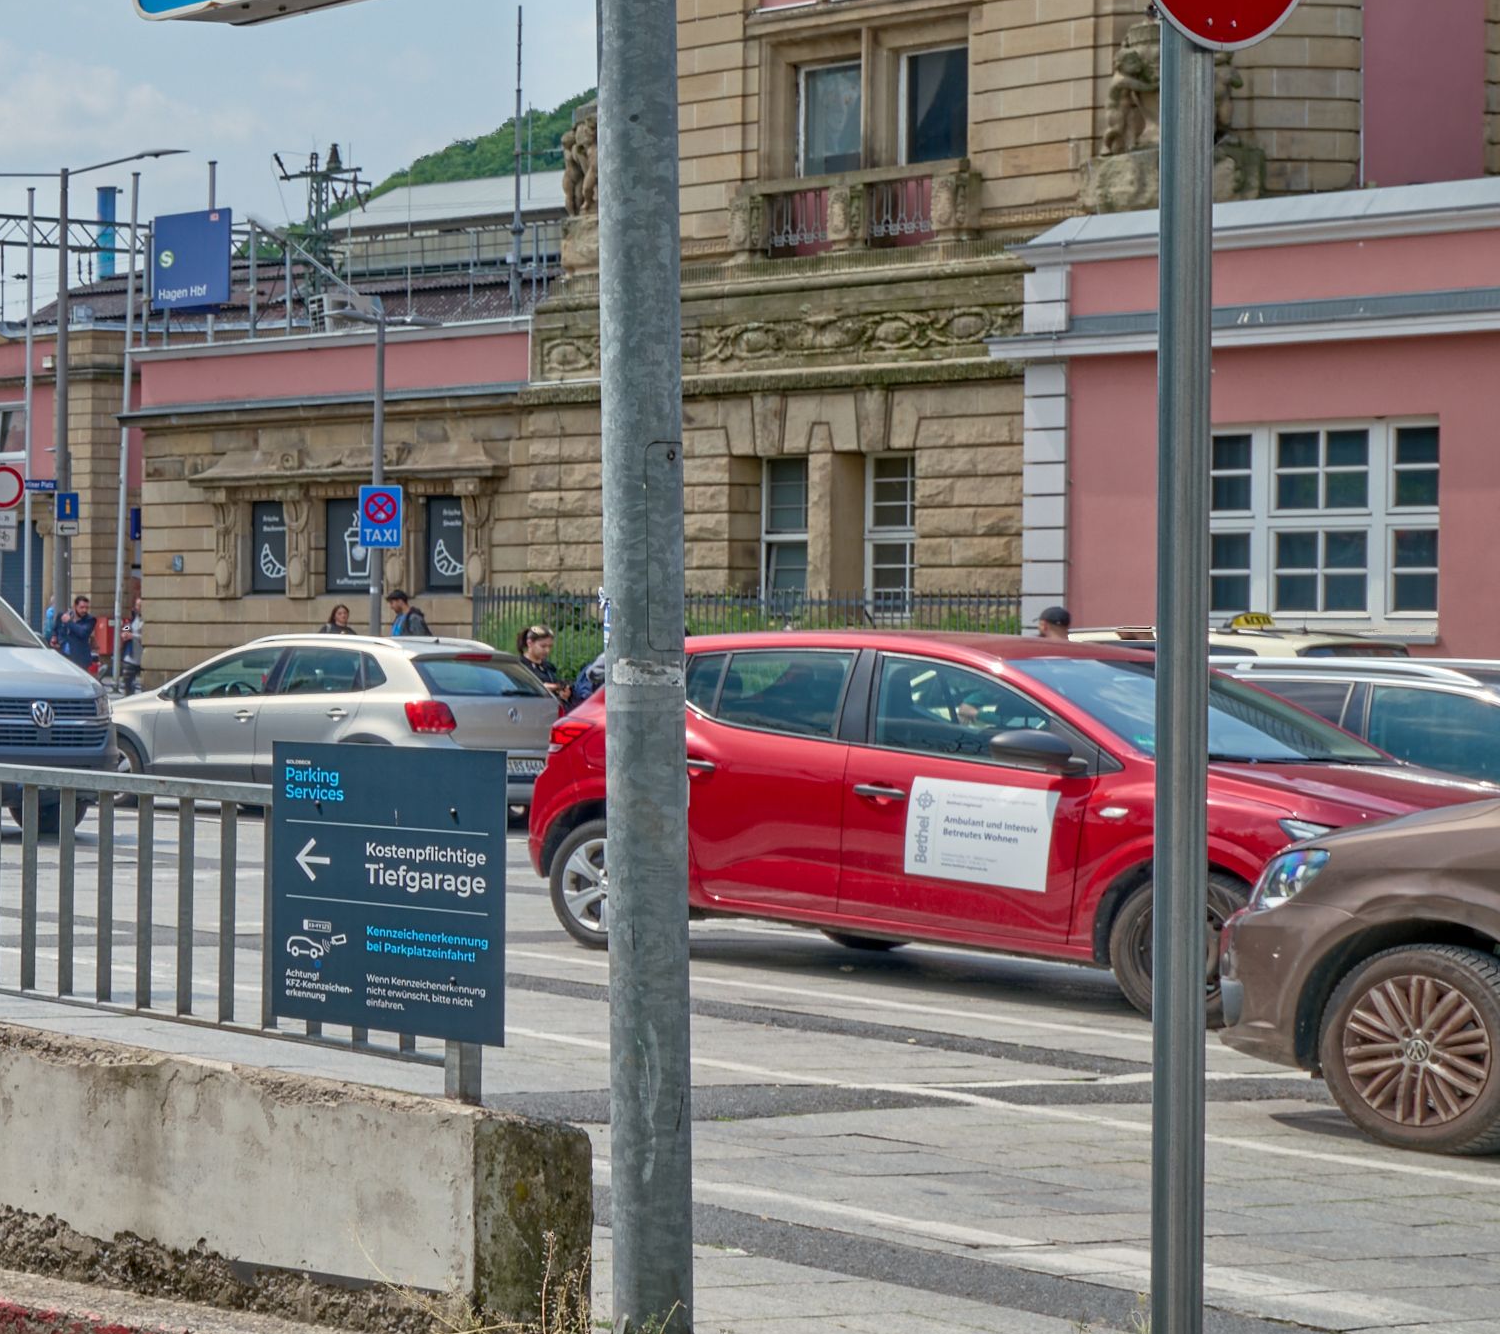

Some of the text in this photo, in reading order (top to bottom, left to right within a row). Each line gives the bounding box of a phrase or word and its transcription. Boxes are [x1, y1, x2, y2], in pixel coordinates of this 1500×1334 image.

[158, 284, 207, 301] Hagen Hbf
[363, 528, 398, 543] TAXI
[285, 767, 339, 786] Parking
[285, 784, 345, 802] Services
[943, 815, 1038, 835] Ambulant und Intensiv
[914, 815, 931, 864] Bethel
[943, 828, 1019, 845] Betreutes Wohnen
[365, 842, 487, 868] Kostenpflichtige
[365, 863, 487, 898] Tiefgarage
[366, 925, 489, 951] Kennzeichenerkennung
[366, 941, 476, 964] bei Parkplatzeinfahrt!
[286, 968, 320, 981] Achtung!
[286, 978, 353, 994] KFZ-Kennzeichen-
[286, 988, 326, 1003] erkennung
[366, 973, 487, 999] Wenn Kennzeichenerkennung
[366, 986, 474, 1009] nicht erwünscht, bitte nicht
[366, 998, 405, 1011] einfahren.
